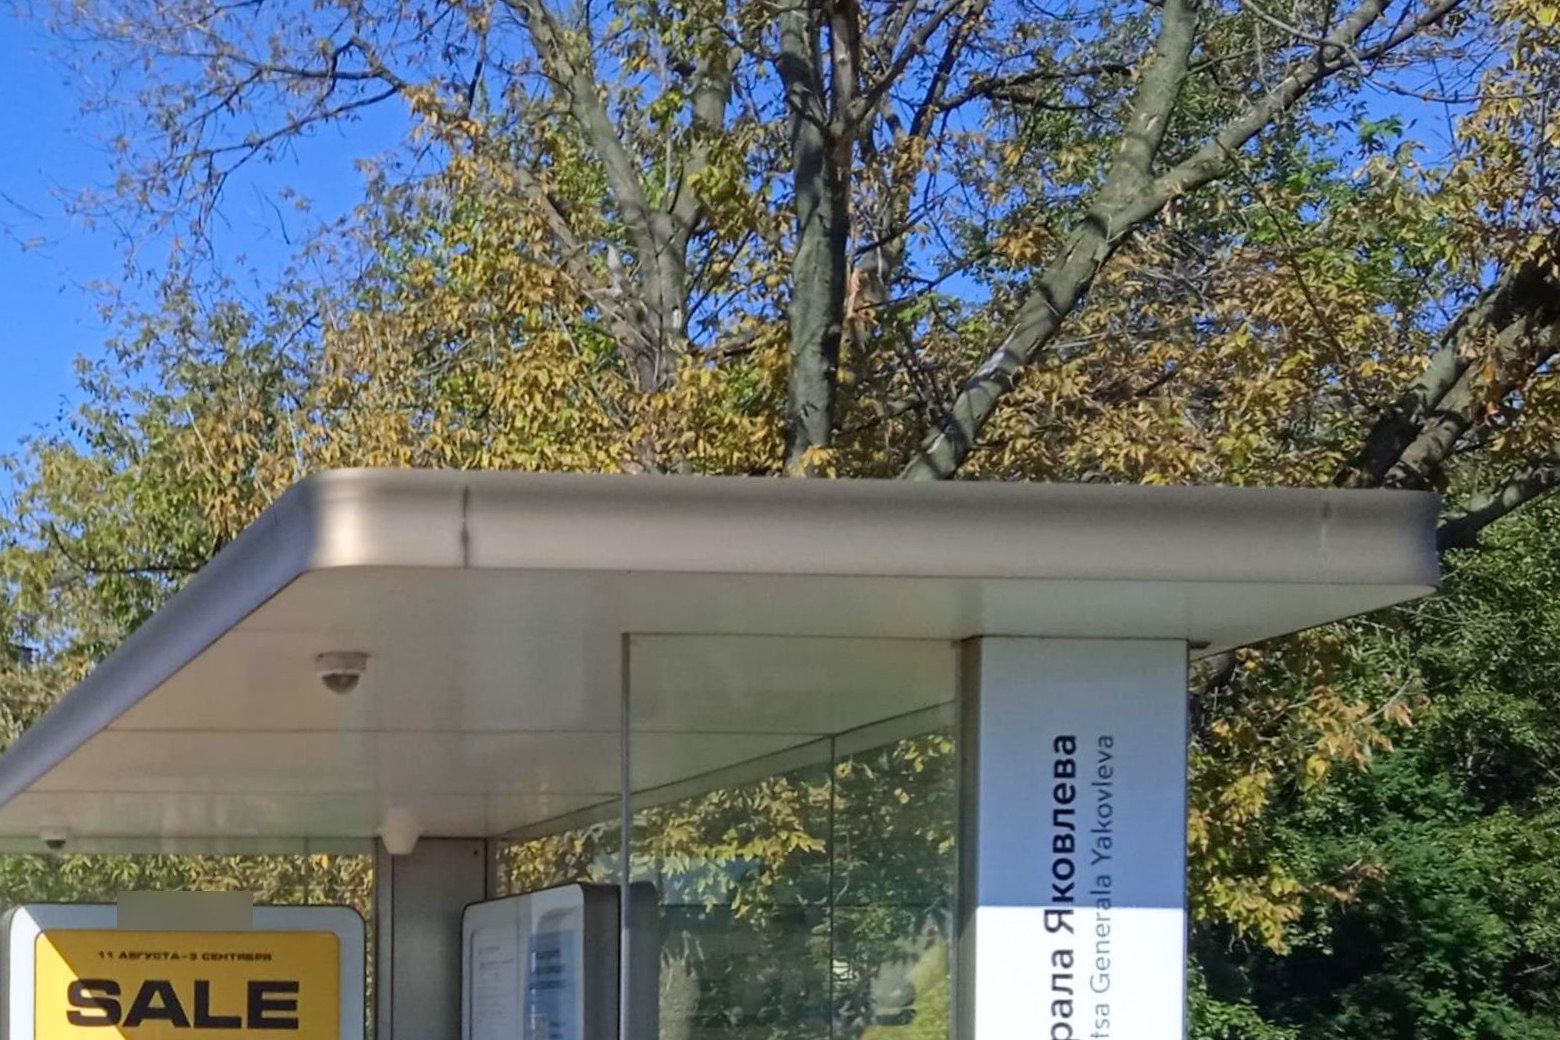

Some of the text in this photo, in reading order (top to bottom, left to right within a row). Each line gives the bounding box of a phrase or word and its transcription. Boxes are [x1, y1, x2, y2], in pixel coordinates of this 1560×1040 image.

[1044, 735, 1077, 934] Яковлева
[1090, 735, 1114, 866] Yakovleva
[99, 951, 113, 960] 11
[202, 952, 272, 961] СЕНТЯБРЯ
[1090, 874, 1111, 993] Generala
[67, 978, 299, 1029] SALE
